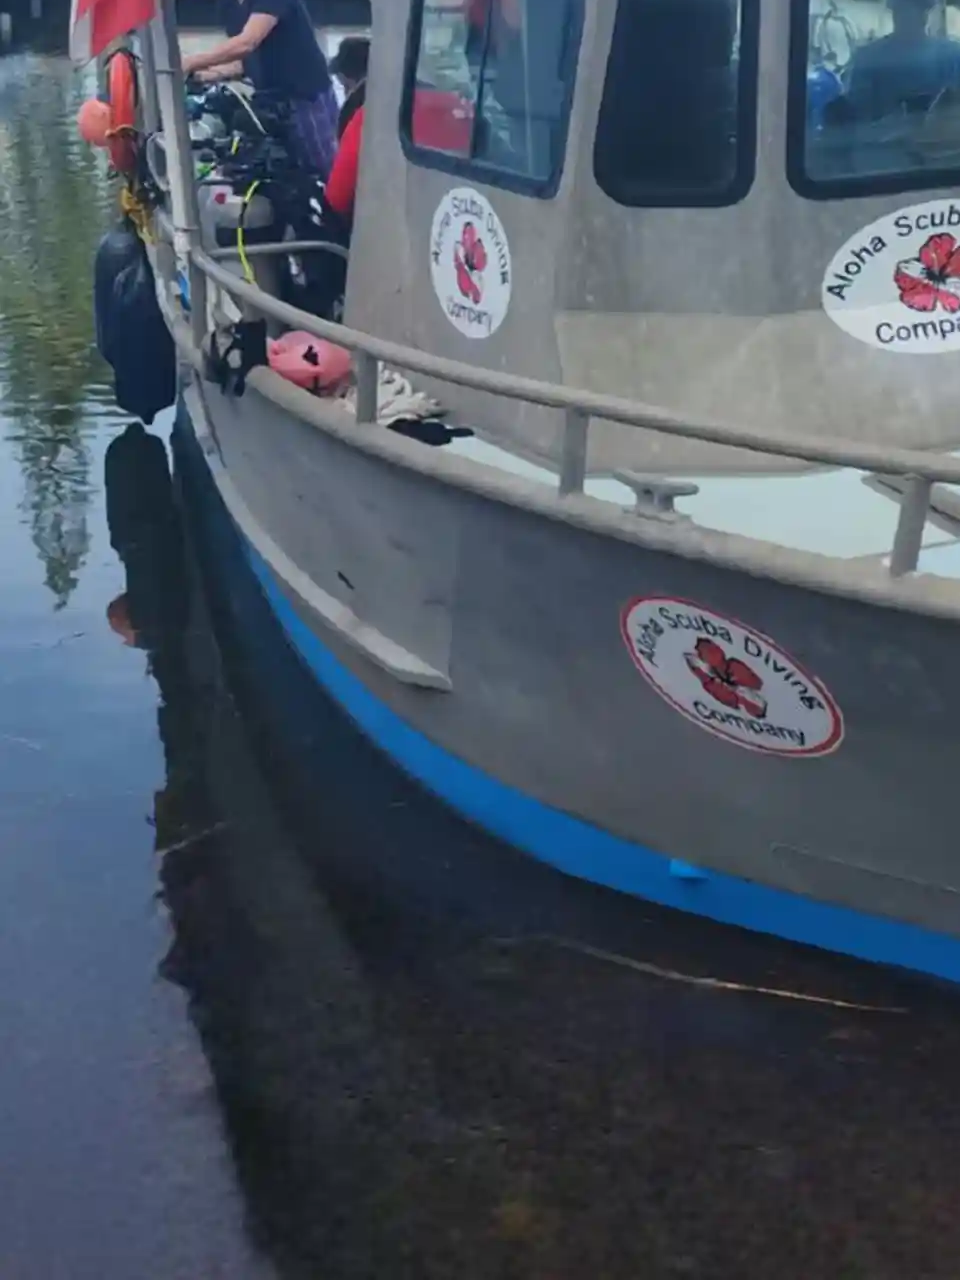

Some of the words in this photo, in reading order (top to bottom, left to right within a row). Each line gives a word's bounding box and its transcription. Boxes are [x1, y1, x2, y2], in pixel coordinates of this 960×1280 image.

[825, 234, 888, 301] Aloha
[657, 606, 734, 646] Scuba
[743, 635, 826, 711] Diving
[692, 700, 806, 747] Company
